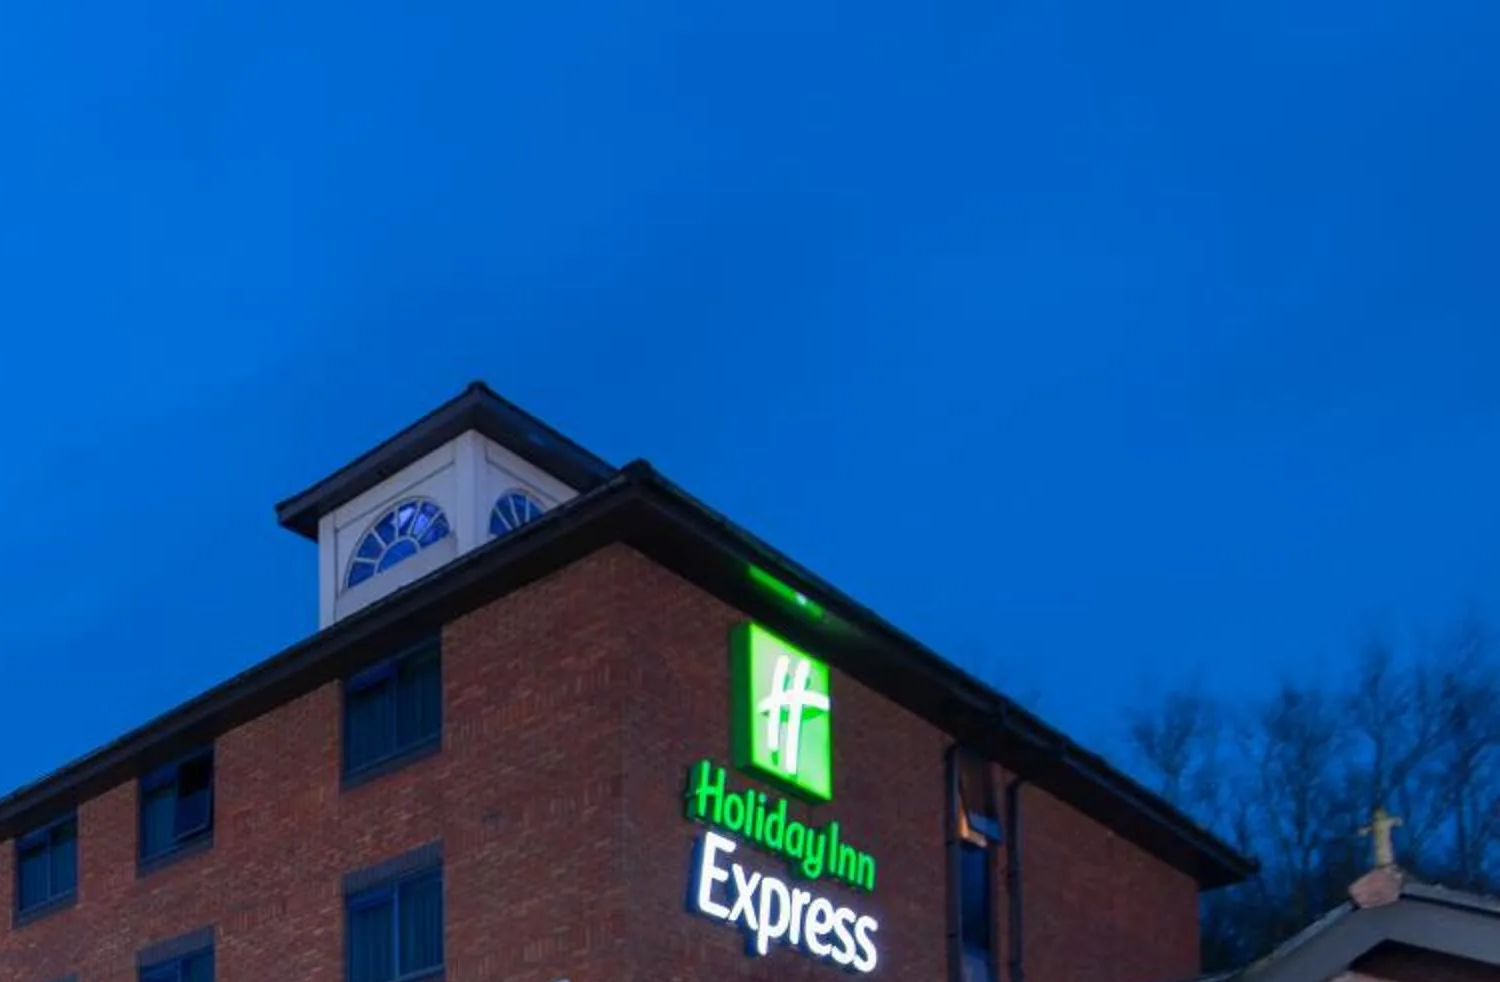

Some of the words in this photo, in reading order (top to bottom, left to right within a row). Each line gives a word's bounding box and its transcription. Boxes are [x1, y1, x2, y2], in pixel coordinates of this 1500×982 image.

[694, 760, 827, 879] Holiday
[831, 821, 876, 891] Inn
[698, 831, 879, 974] Express
